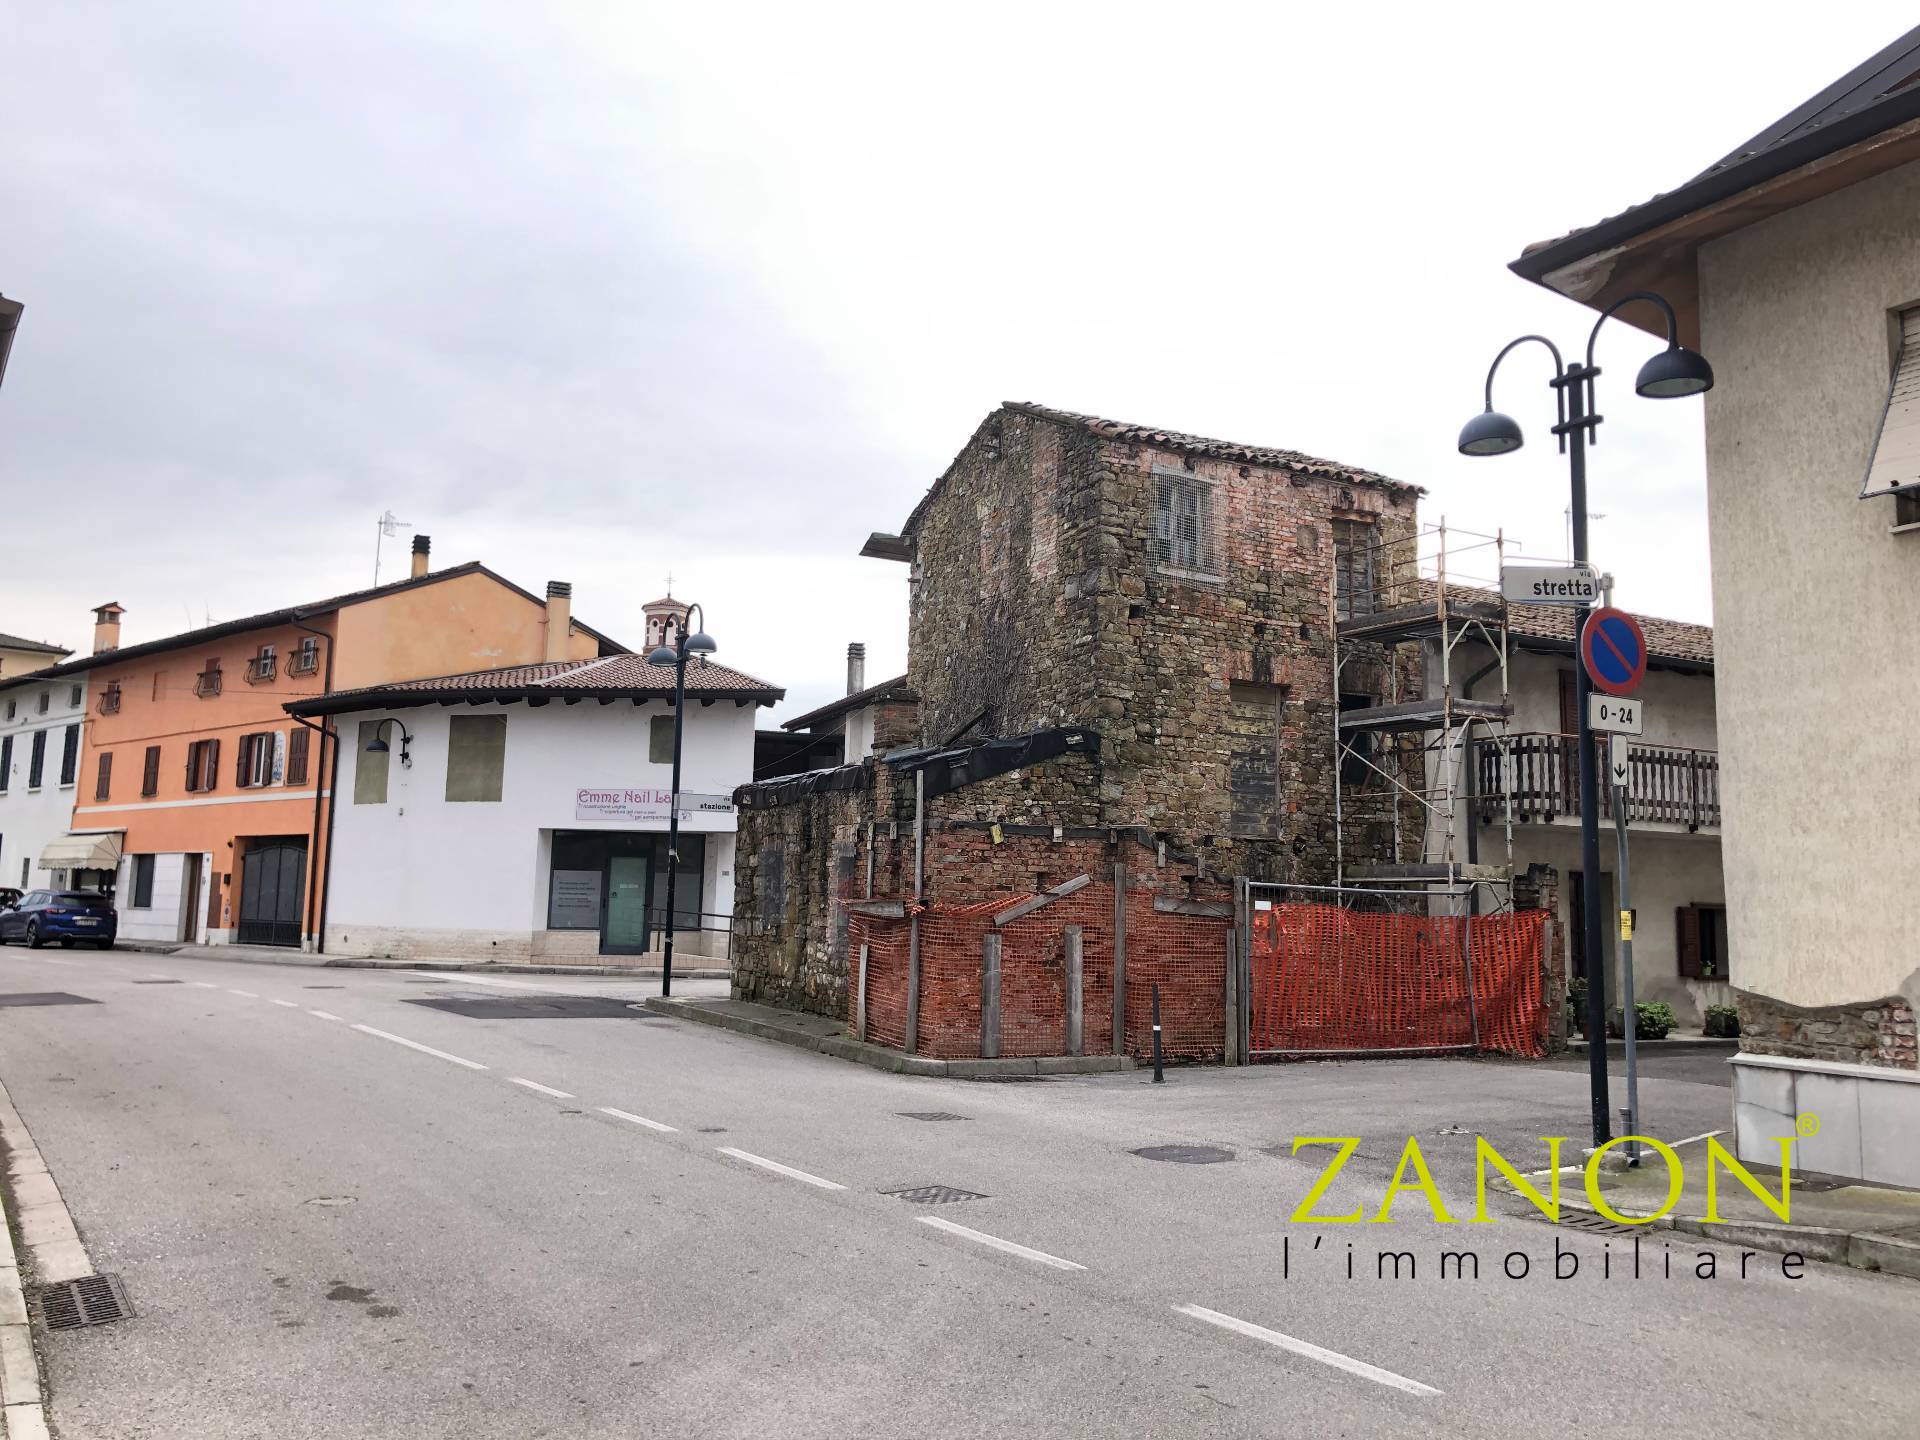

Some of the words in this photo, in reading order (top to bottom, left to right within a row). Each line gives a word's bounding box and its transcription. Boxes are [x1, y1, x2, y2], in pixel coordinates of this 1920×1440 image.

[1579, 570, 1591, 578] via
[1533, 578, 1593, 596] stretta
[1600, 704, 1608, 721] 0
[1619, 707, 1633, 725] 24
[578, 789, 621, 804] Emme
[624, 790, 650, 804] Nail
[655, 790, 672, 804] La
[700, 802, 731, 811] stazione
